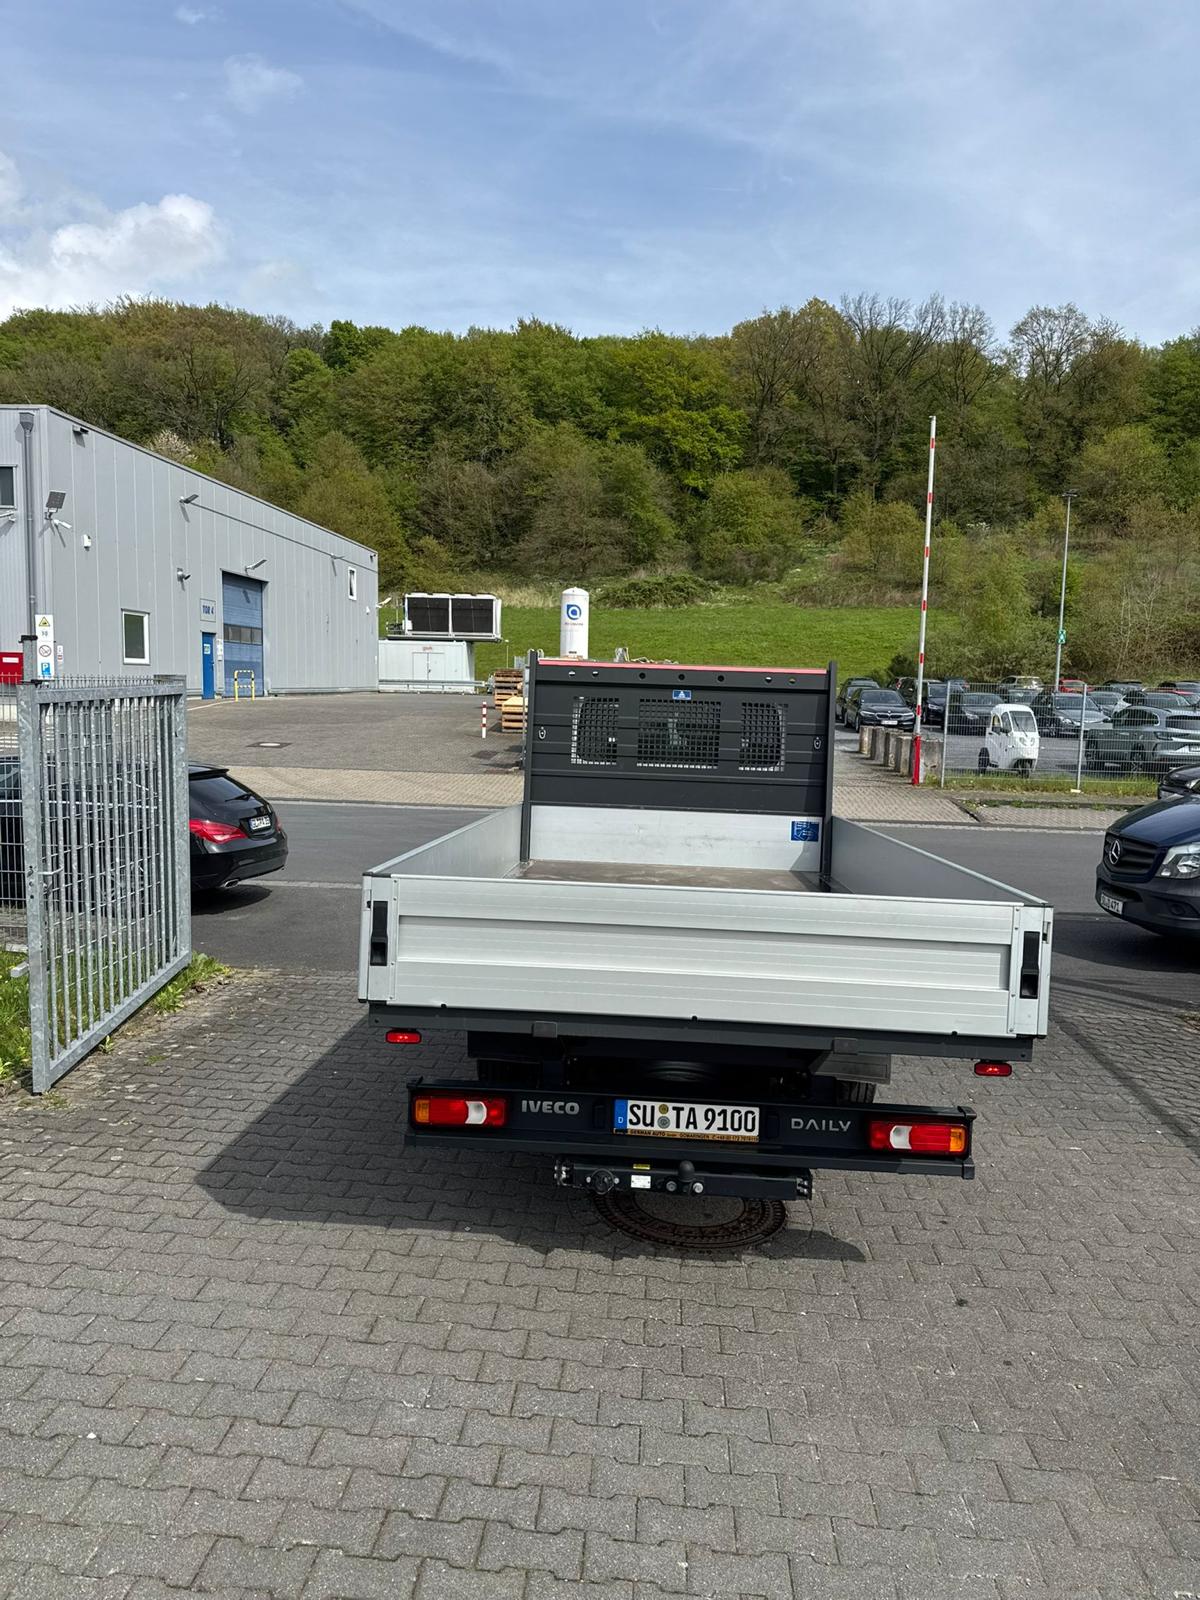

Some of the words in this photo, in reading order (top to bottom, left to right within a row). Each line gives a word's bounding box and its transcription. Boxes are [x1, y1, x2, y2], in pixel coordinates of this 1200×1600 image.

[521, 1100, 580, 1115] IVECO
[628, 1104, 655, 1127] SU
[672, 1106, 698, 1129] TA
[704, 1108, 756, 1132] 9100
[791, 1118, 851, 1132] DAILY
